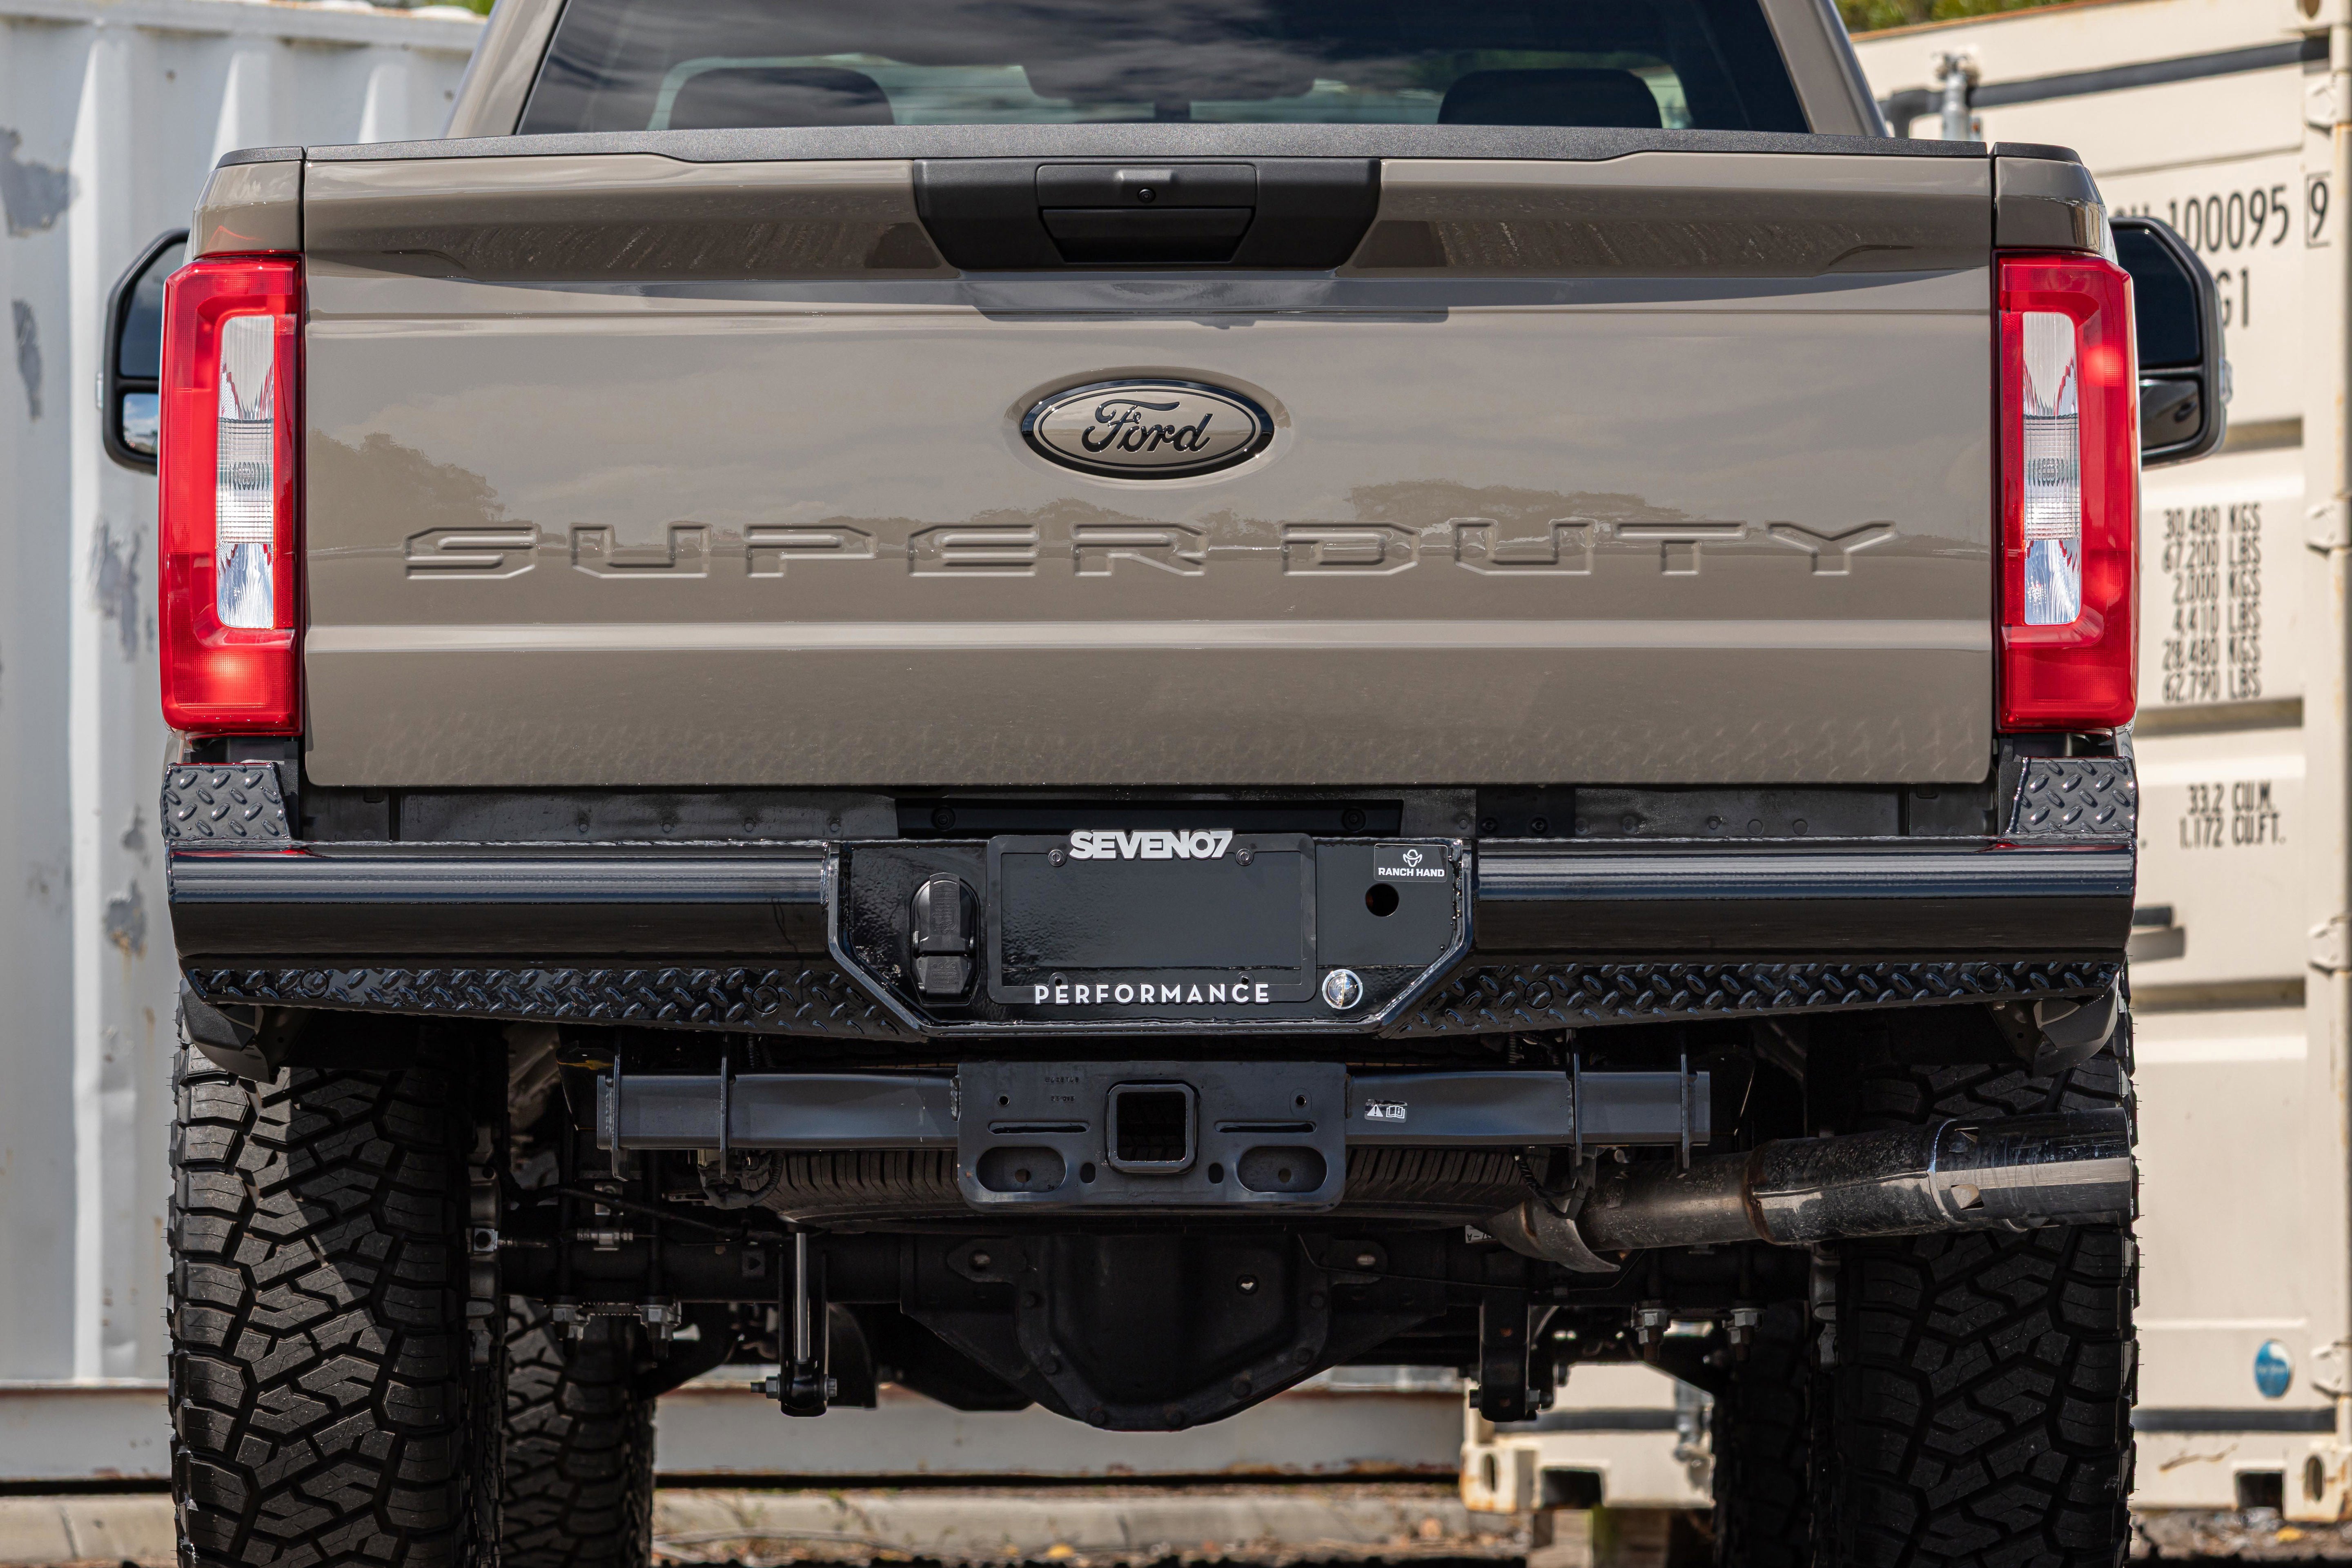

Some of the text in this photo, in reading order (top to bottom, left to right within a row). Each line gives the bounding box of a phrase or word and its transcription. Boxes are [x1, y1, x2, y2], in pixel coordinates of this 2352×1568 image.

[2310, 181, 2329, 239] 9
[1081, 399, 1214, 453] Ford
[2227, 502, 2261, 532] KGS
[405, 518, 1899, 579] SUPER DUTY
[2227, 535, 2261, 566] LBS
[2227, 569, 2261, 598] KGS
[2227, 601, 2261, 633] LBS
[2227, 635, 2261, 666] KGS
[2227, 668, 2261, 700] LBS
[1378, 867, 1445, 877] RANCH HAND
[1034, 984, 1270, 1004] PERFORMANCE
